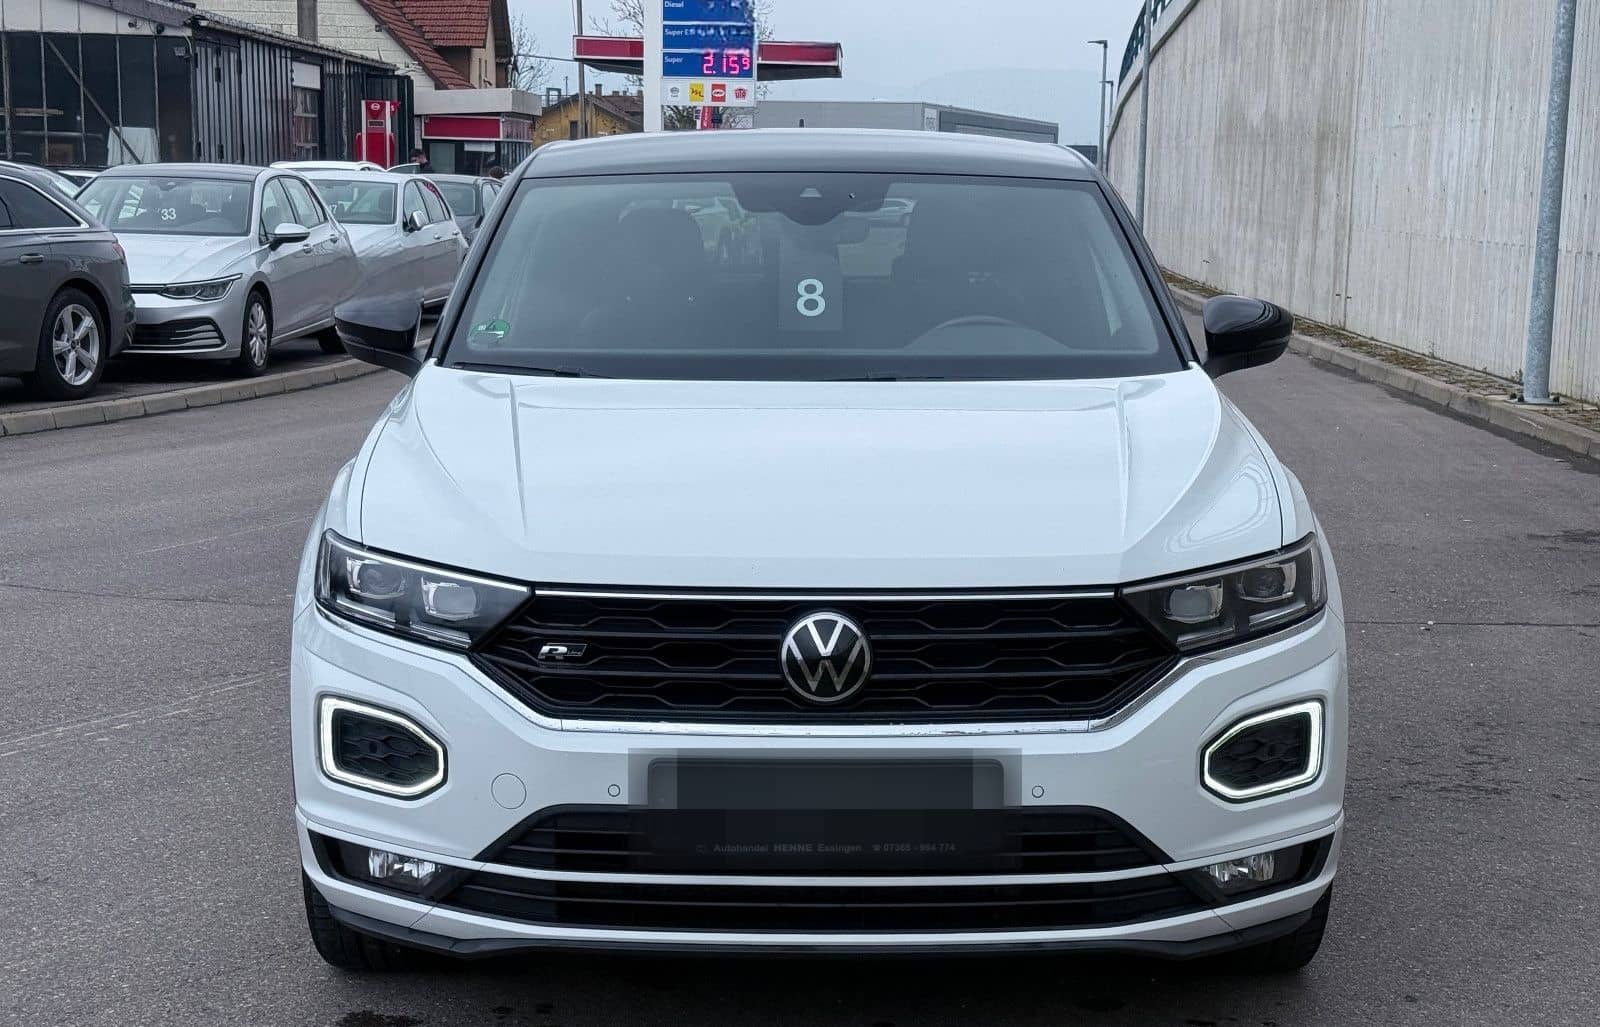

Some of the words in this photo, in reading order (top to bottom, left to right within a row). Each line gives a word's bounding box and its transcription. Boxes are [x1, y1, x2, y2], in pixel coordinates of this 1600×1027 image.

[664, 0, 684, 8] Diesel
[664, 56, 683, 64] Super
[161, 207, 176, 220] 33
[797, 279, 825, 316] 8
[713, 843, 769, 852] Autohandel
[773, 843, 813, 852] HENNE
[817, 843, 863, 854] Essingen
